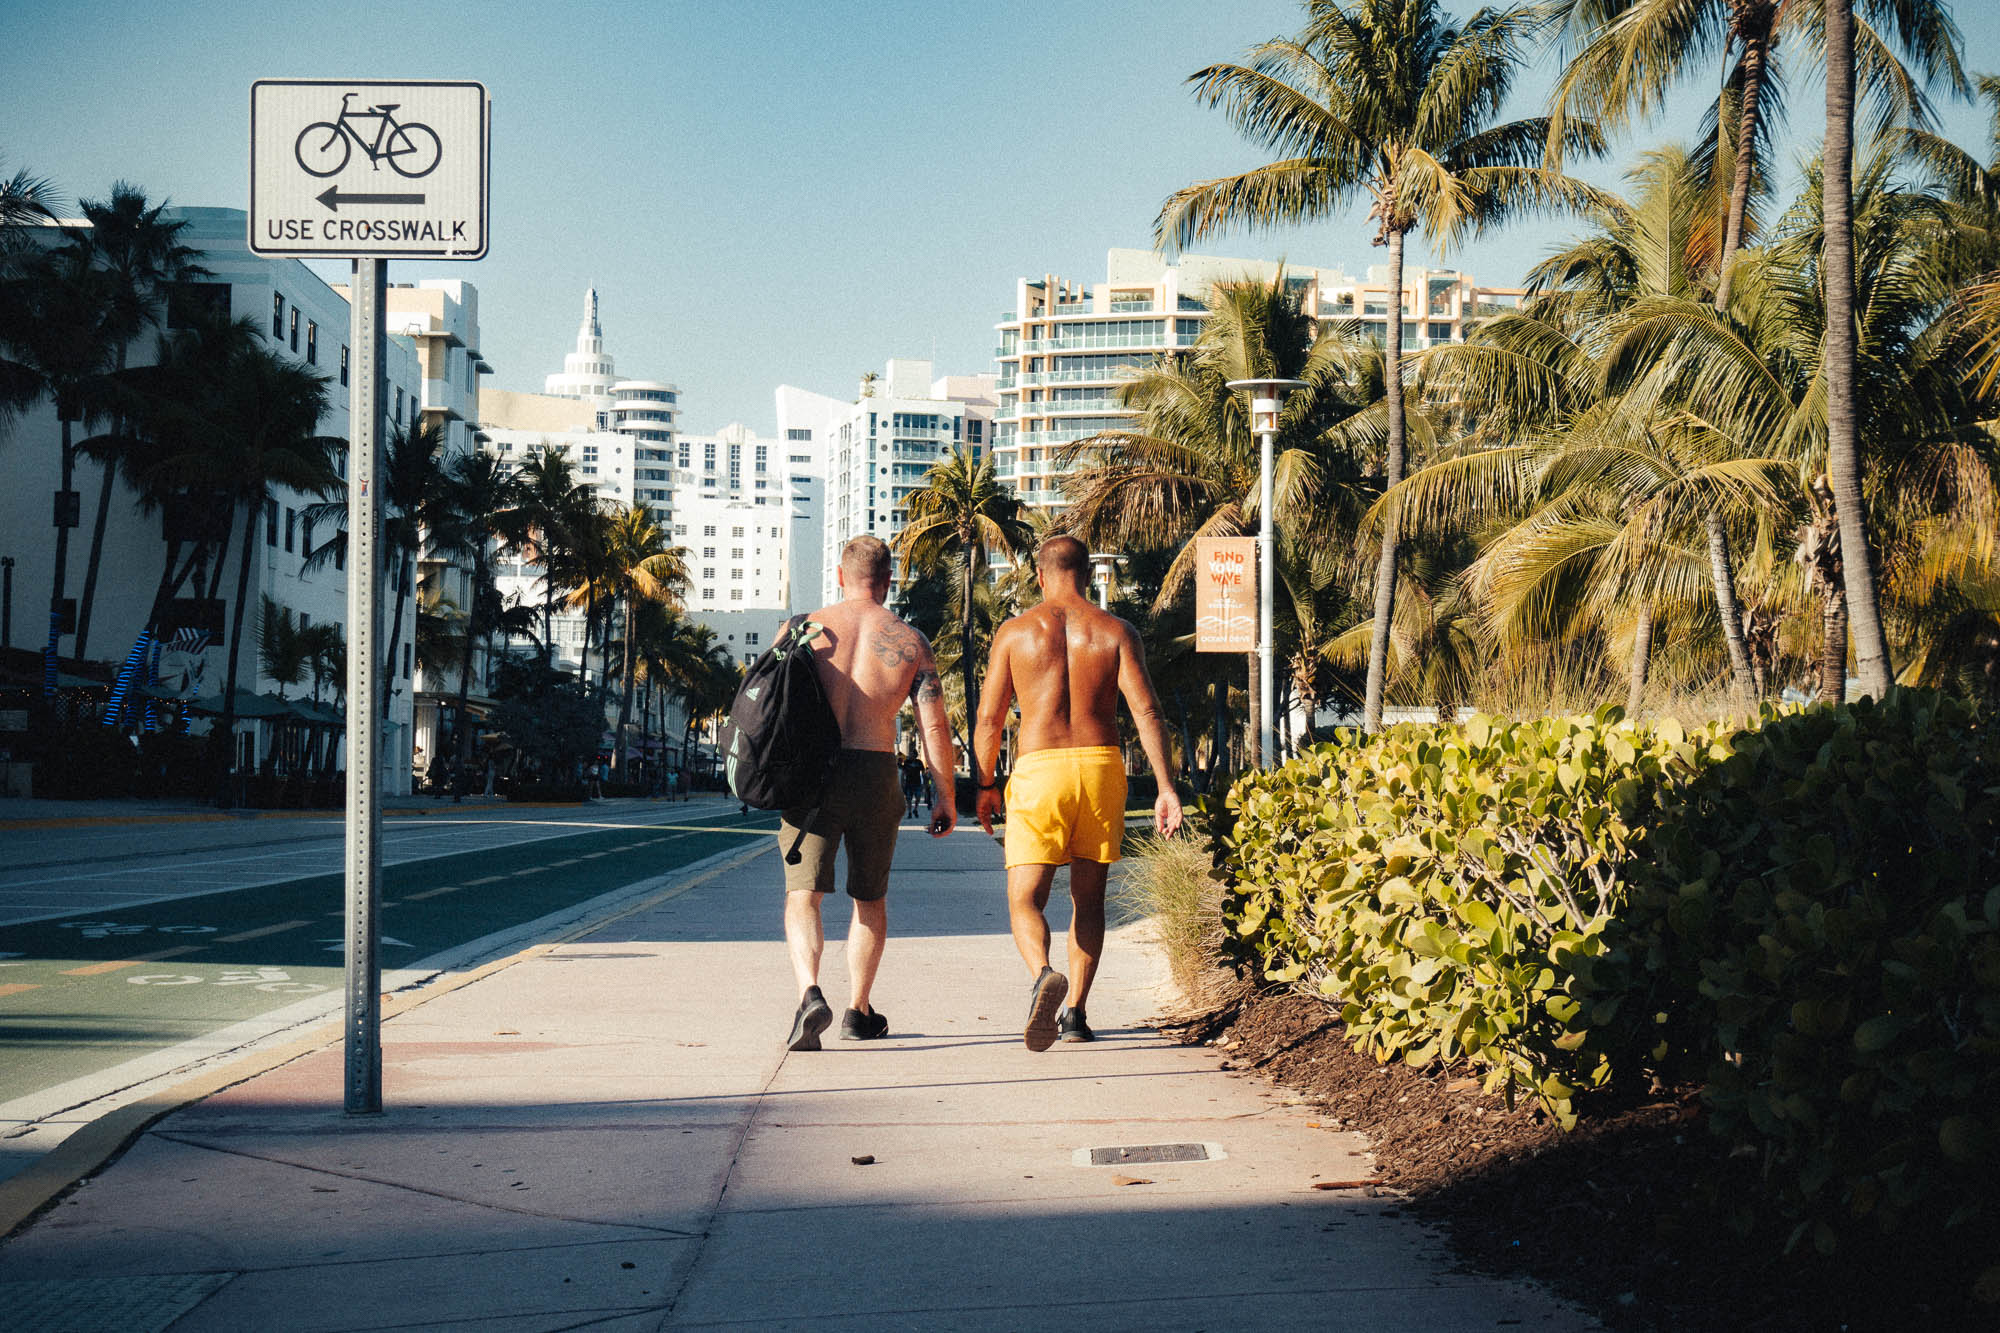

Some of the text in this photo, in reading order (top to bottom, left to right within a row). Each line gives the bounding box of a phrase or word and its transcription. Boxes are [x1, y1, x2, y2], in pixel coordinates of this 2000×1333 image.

[268, 219, 467, 241] USE CROSSWALK
[1214, 551, 1244, 564] FIND
[1208, 561, 1244, 574] YOUR
[1211, 572, 1241, 584] WAVE
